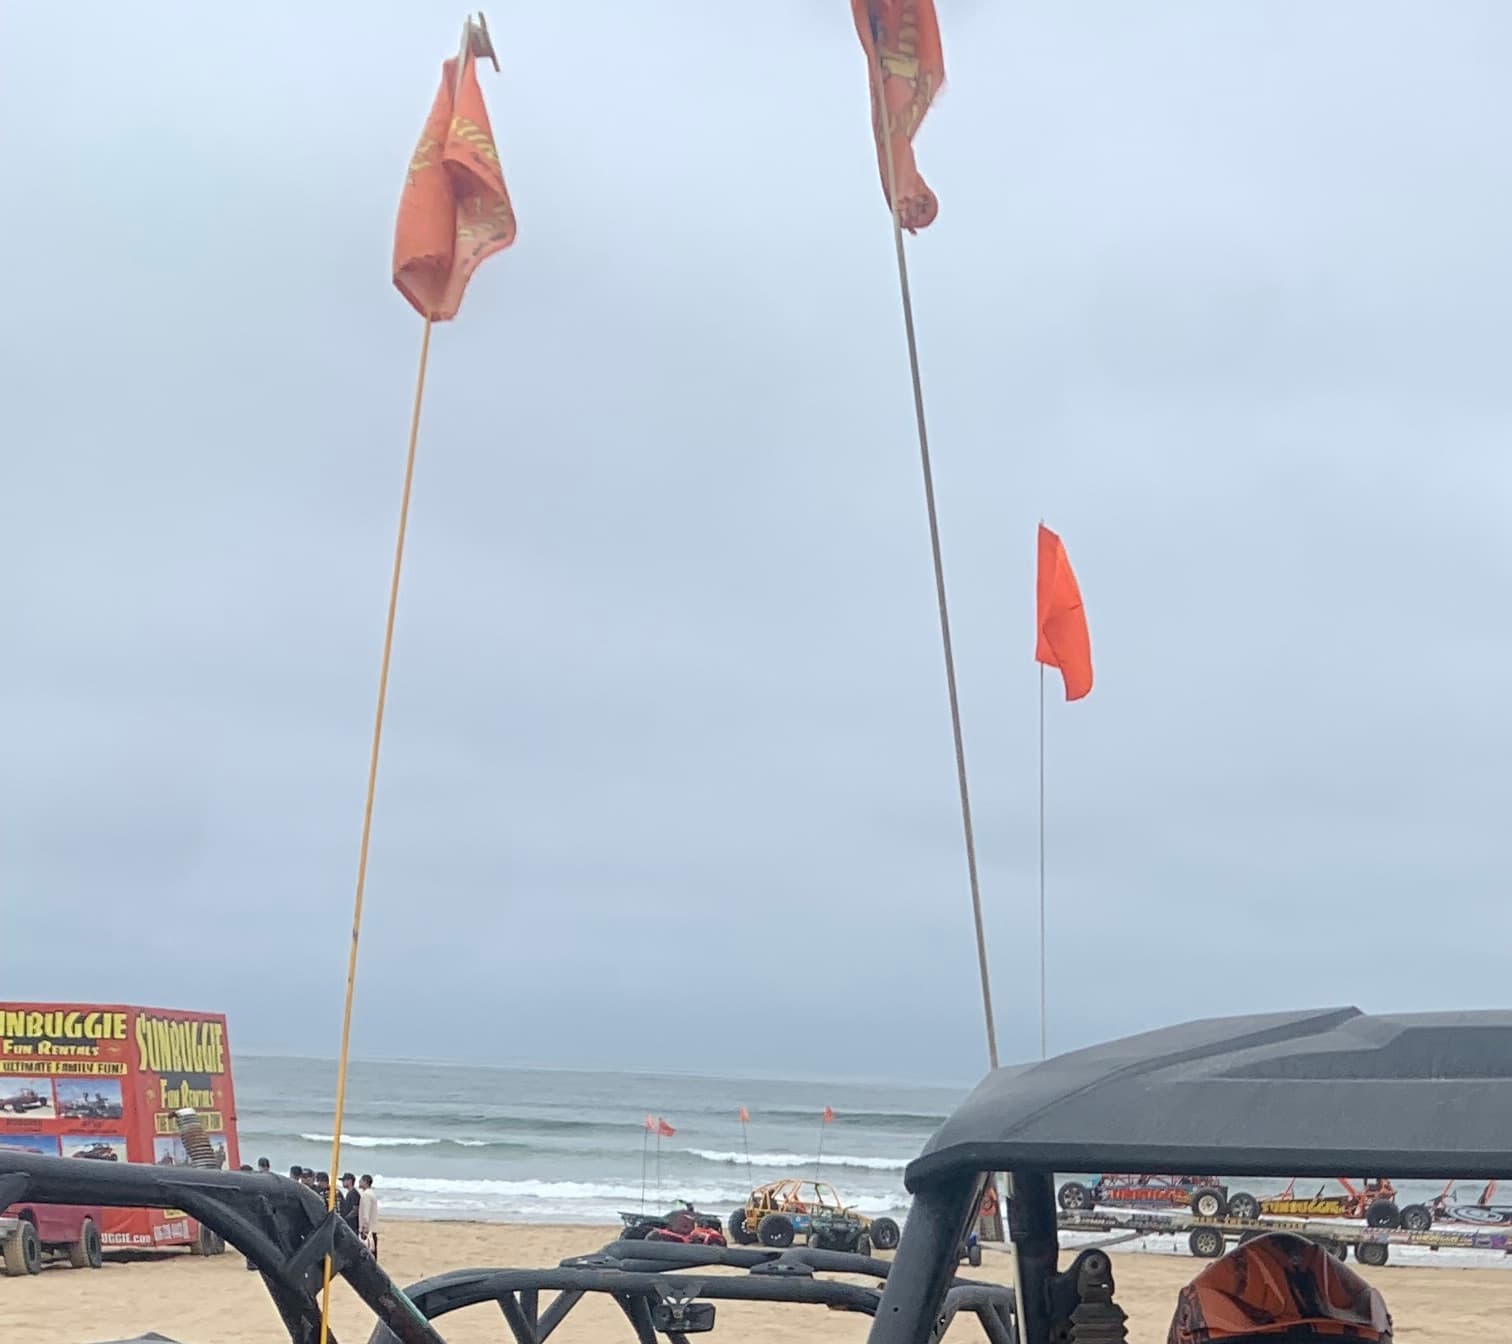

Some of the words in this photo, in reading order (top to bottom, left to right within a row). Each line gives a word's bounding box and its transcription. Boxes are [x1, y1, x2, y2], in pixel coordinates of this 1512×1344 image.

[0, 1010, 128, 1039] NBUGGIE
[135, 1012, 225, 1073] SUNBUGGIE
[3, 1061, 52, 1073] ULTIMATE
